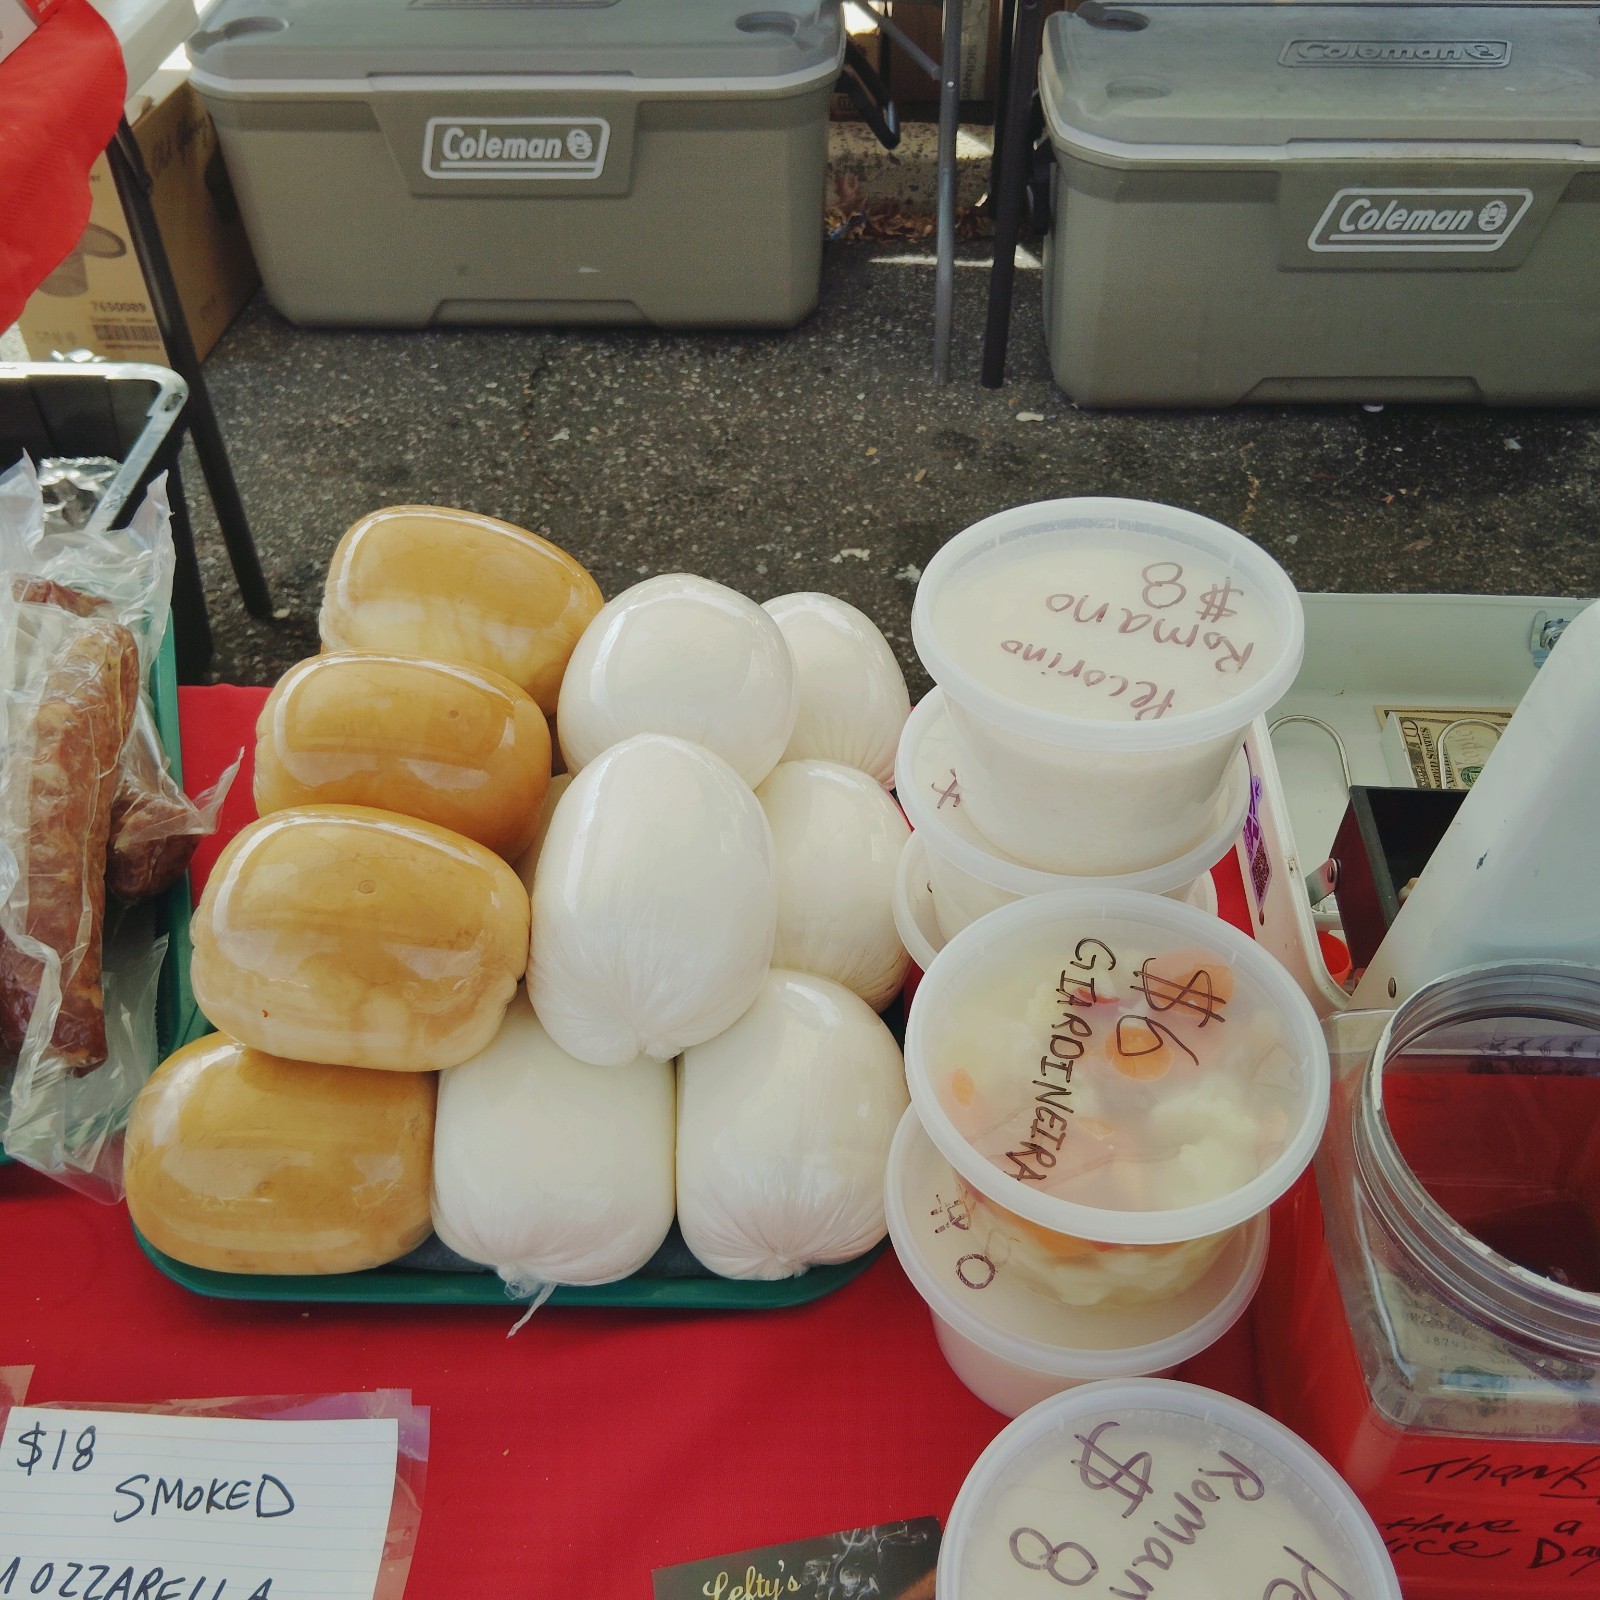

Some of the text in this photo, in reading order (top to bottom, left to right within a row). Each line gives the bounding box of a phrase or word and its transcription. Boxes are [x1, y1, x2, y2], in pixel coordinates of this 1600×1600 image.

[1298, 44, 1464, 61] Coleman
[442, 127, 563, 160] Coleman
[1338, 198, 1474, 232] Coleman
[1046, 593, 1254, 673] Romano
[1000, 638, 1176, 720] Pecorino
[1116, 957, 1226, 1066] $6
[1003, 937, 1117, 1181] GIARDINEIRA
[16, 1421, 97, 1475] $18
[114, 1473, 296, 1522] SMOKED
[1380, 1513, 1582, 1536] Have a
[1386, 1537, 1512, 1558] ice
